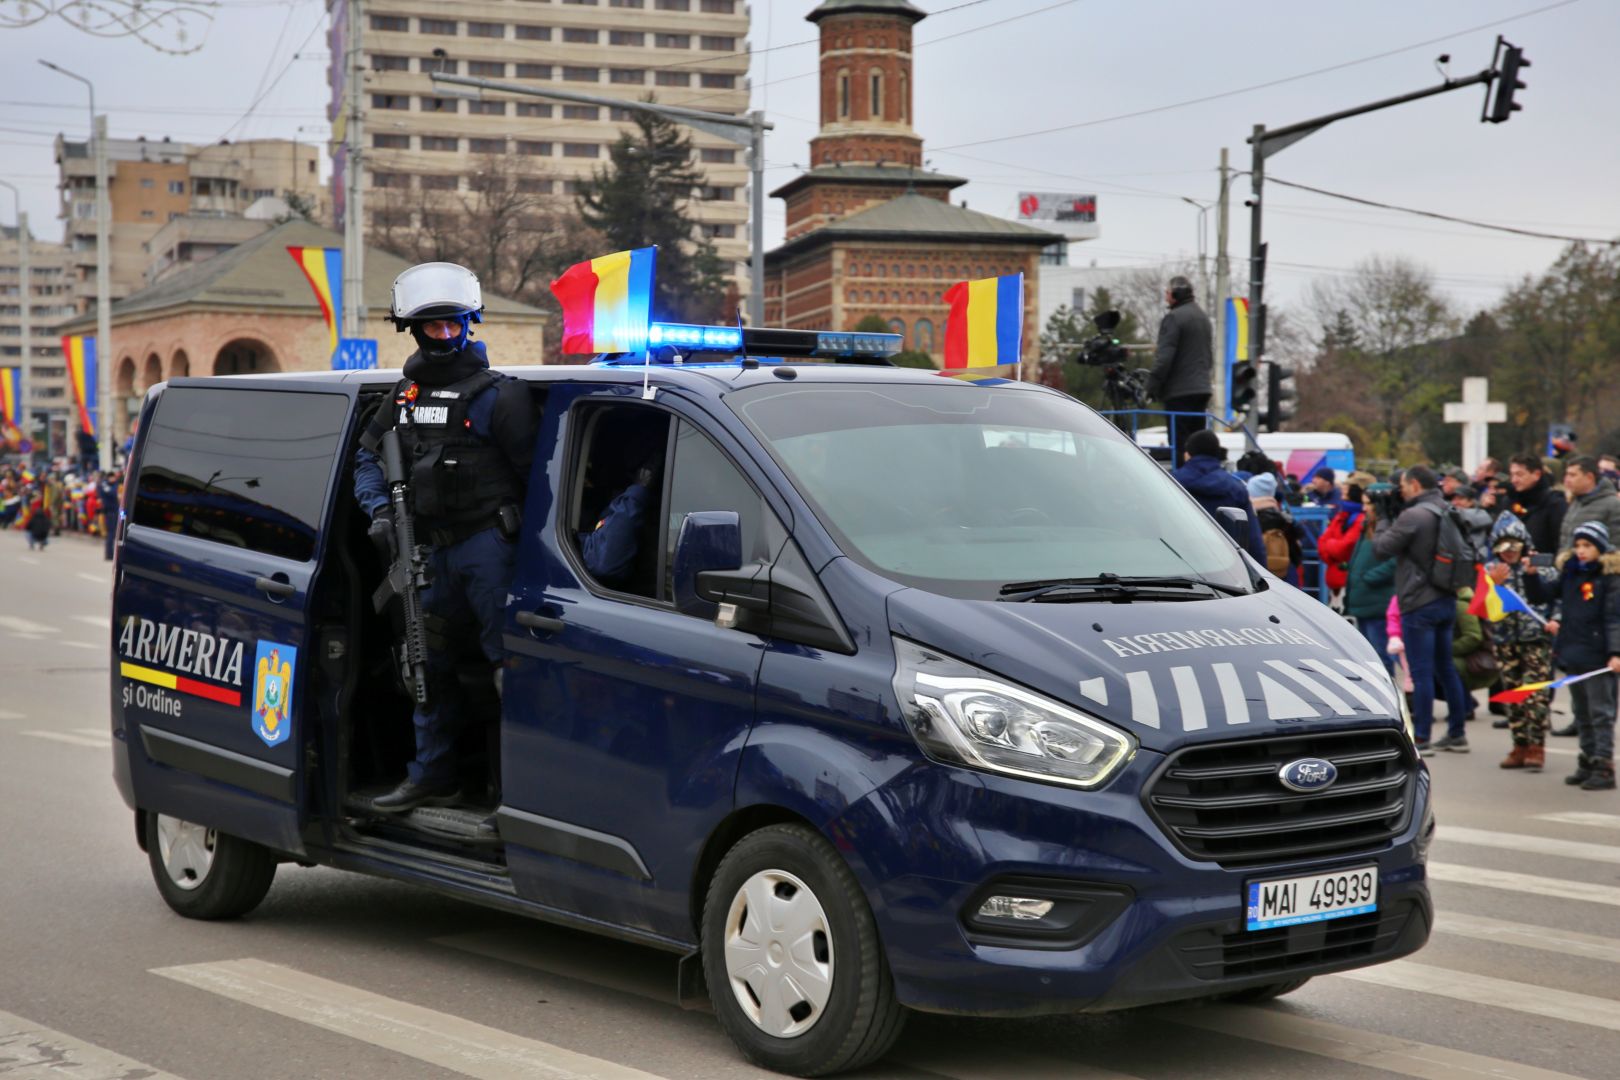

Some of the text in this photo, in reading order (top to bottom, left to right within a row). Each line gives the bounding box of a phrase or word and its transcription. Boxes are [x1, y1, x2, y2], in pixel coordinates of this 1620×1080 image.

[136, 685, 182, 717] Ordine
[1297, 763, 1329, 784] Ford
[1263, 872, 1372, 917] MAI 49939
